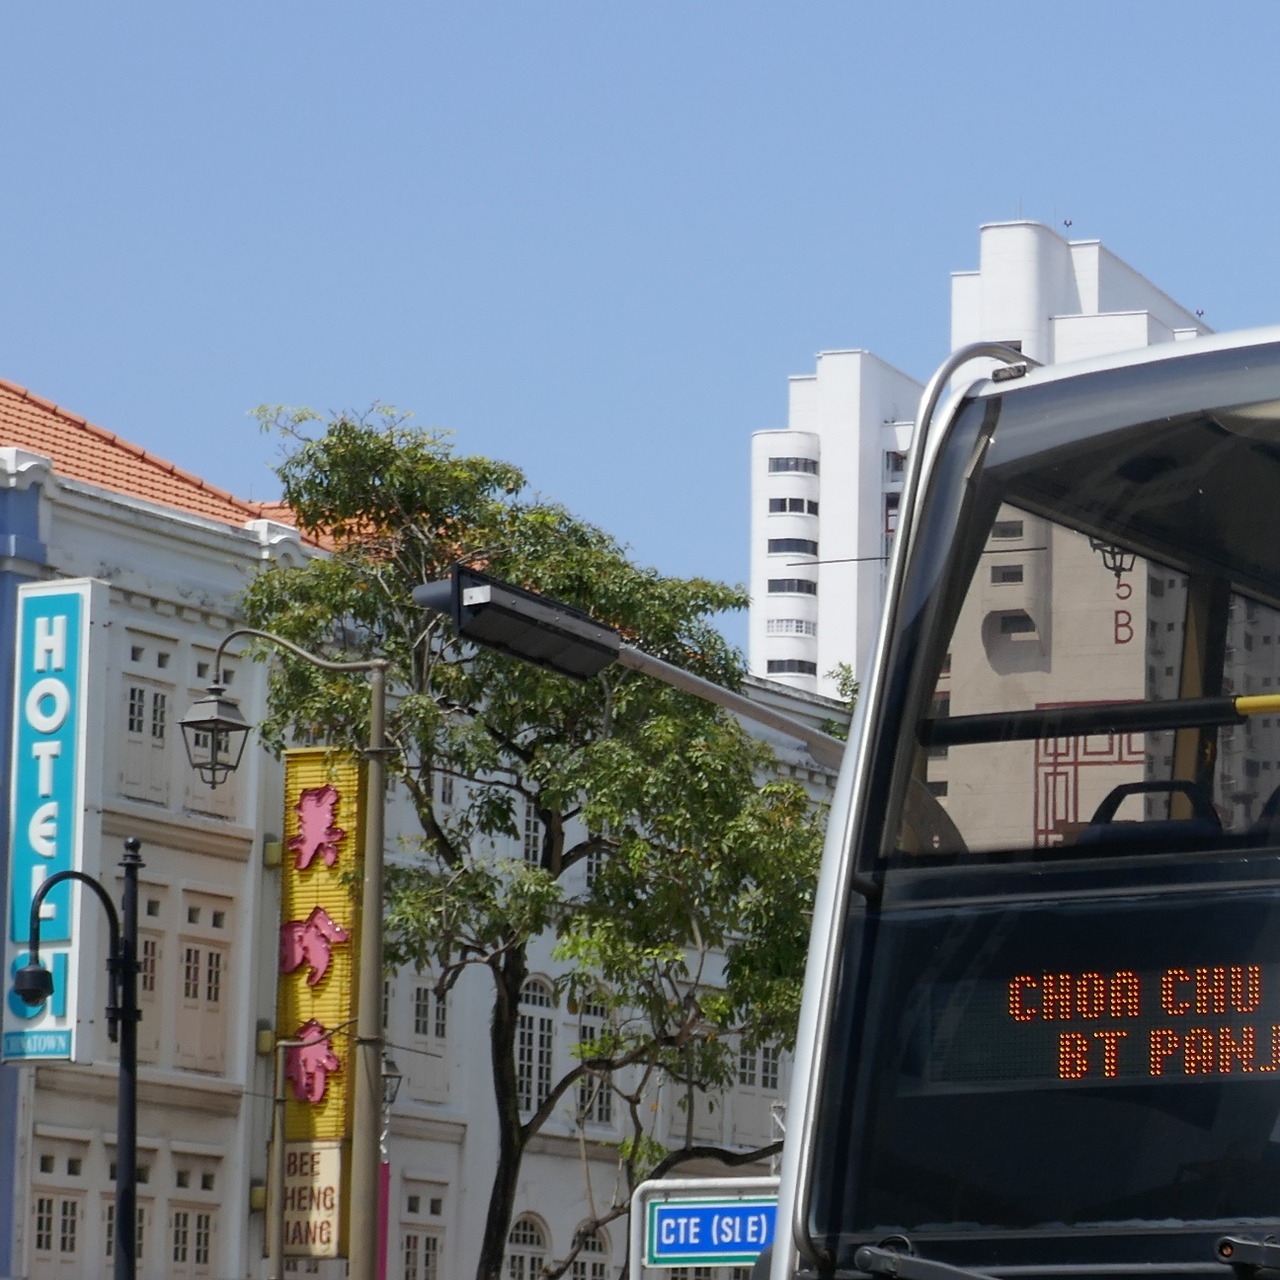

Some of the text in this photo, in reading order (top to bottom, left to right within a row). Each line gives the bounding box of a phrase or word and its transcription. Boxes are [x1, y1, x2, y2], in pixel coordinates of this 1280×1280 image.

[25, 615, 71, 920] HOTEL
[1008, 970, 1140, 1022] CHOA
[1161, 966, 1261, 1015] CHU
[1058, 1030, 1129, 1079] BT
[287, 1151, 321, 1178] BEE
[284, 1185, 335, 1212] HENG
[284, 1219, 332, 1246] IANG
[661, 1217, 700, 1245] CTE
